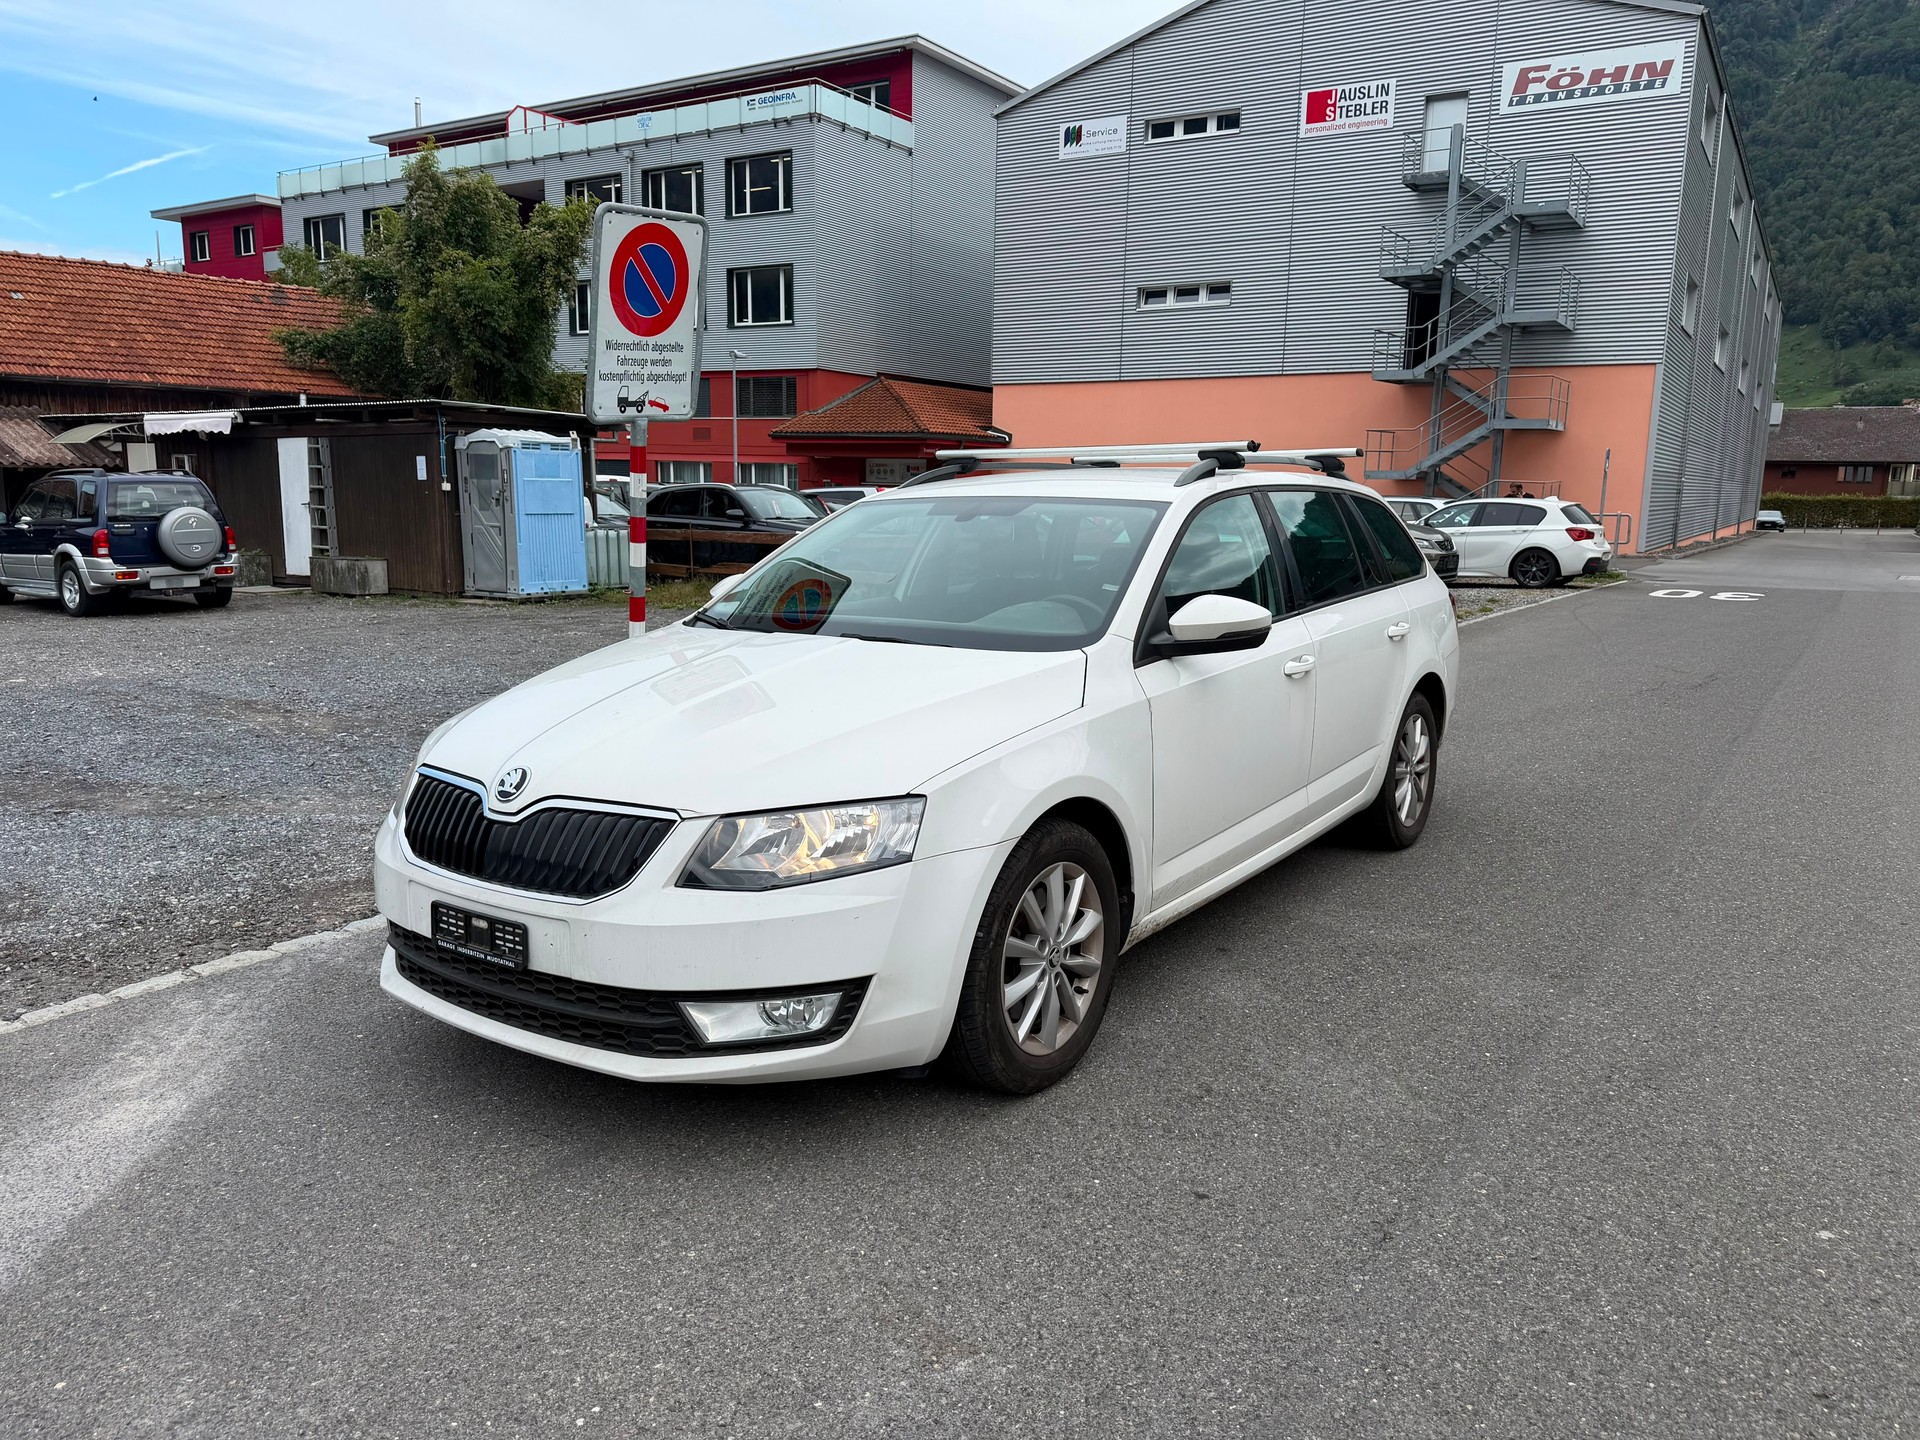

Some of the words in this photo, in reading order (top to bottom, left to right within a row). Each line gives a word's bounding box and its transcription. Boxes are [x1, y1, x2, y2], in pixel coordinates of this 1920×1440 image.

[1511, 59, 1675, 96] FÖHN
[757, 91, 797, 105] GEOINFRA
[1511, 79, 1665, 106] TRANSPORTE
[1304, 121, 1347, 135] personalized
[1347, 118, 1388, 129] engineering
[605, 339, 650, 352] Widerrechtlich
[651, 341, 684, 355] abgestellte
[616, 355, 649, 370] Fahrzeuge
[649, 356, 673, 367] werden
[598, 369, 645, 385] kostenpflichtig
[646, 370, 687, 385] abgeschleppt!
[437, 939, 456, 950] GARAGE
